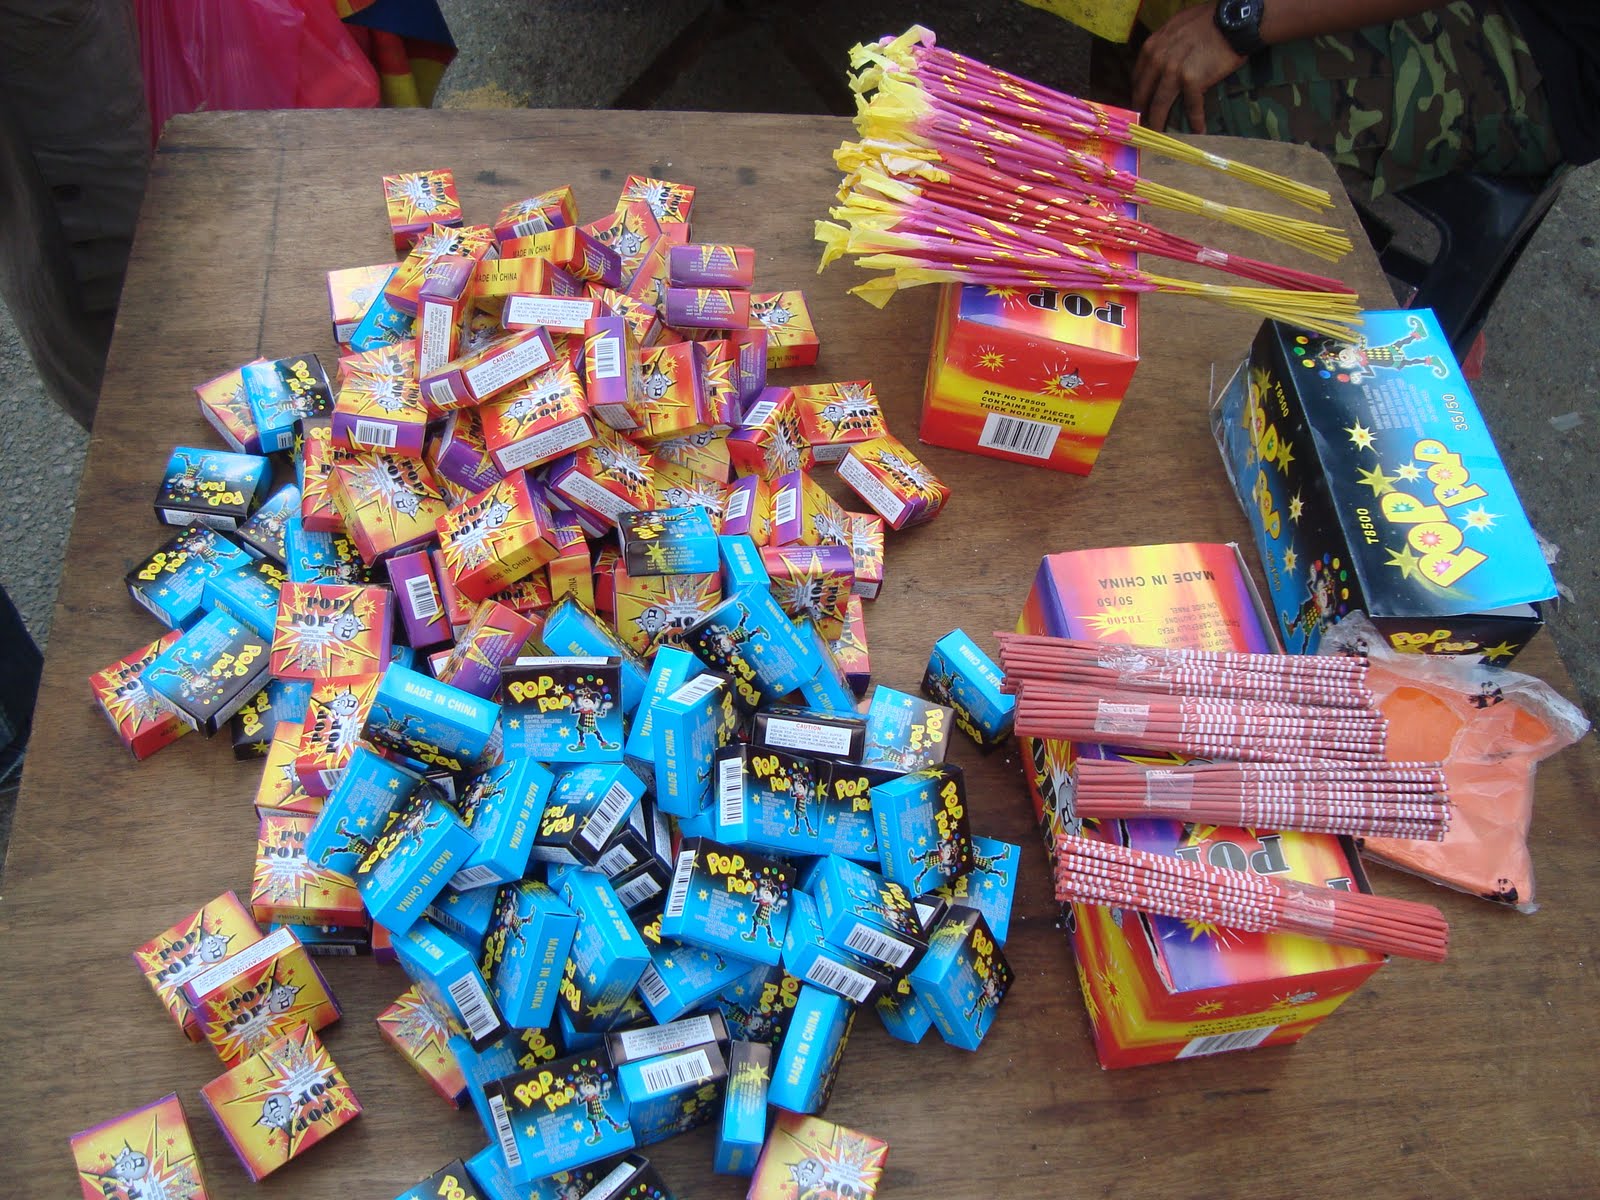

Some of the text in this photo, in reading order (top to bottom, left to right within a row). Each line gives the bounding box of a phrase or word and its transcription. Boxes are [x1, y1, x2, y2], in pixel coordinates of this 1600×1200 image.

[434, 181, 445, 201] POP
[670, 195, 682, 212] POP
[513, 245, 551, 257] MADE IN CHINA
[492, 273, 517, 281] IN CHINA
[1027, 288, 1126, 328] POP
[492, 349, 515, 364] CAUTION
[290, 360, 316, 385] POP
[535, 387, 571, 407] POP
[982, 397, 1027, 409] CONTAINS
[1044, 409, 1075, 419] PIECES
[1020, 398, 1046, 406] T8500
[1274, 381, 1289, 418] T8500
[527, 403, 562, 422] POP
[842, 420, 872, 429] POP
[848, 409, 878, 417] POP
[980, 403, 1076, 425] TRICK NOISE MAKERS
[1442, 394, 1468, 431] 35/50
[535, 444, 562, 458] CAUTION
[382, 455, 404, 486] POP
[402, 460, 424, 491] POP
[865, 472, 884, 490] CAUTION
[1414, 438, 1488, 508] POP
[199, 481, 226, 492] POP
[208, 490, 245, 506] POP
[458, 499, 490, 523] POP
[450, 519, 483, 542] POP
[1357, 508, 1379, 545] T8500
[333, 539, 351, 561] POP
[1381, 491, 1488, 588] POP
[139, 552, 167, 581] POP
[164, 552, 188, 573] POP
[512, 556, 533, 569] CHINA
[1098, 571, 1215, 589] MADE IN CHINA
[307, 597, 345, 609] POP
[826, 586, 838, 611] POP
[1097, 595, 1133, 607] 50/50
[1191, 604, 1206, 612] SIDE
[292, 613, 329, 627] POP
[1107, 614, 1142, 624] T8500
[1157, 627, 1174, 635] READ
[1164, 615, 1196, 624] CAUTIONS
[1390, 630, 1452, 645] POP
[1433, 642, 1479, 652] POP
[211, 652, 235, 677] POP
[233, 645, 262, 676] POP
[959, 645, 981, 666] CHINA
[508, 675, 554, 703] POP
[656, 668, 672, 694] MADE
[404, 682, 478, 718] MADE IN CHINA
[538, 695, 572, 713] POP
[722, 691, 735, 730] POP
[312, 710, 329, 742] POP
[326, 720, 339, 753] POP
[910, 724, 922, 750] POP
[925, 708, 943, 743] POP
[420, 753, 462, 771] POP
[665, 729, 678, 796] MADE IN CHINA
[752, 755, 780, 779] POP
[770, 775, 791, 792] POP
[834, 777, 870, 800] POP
[941, 782, 964, 820] POP
[509, 782, 540, 849] MADE IN CHINA
[542, 814, 575, 836] POP
[879, 812, 889, 838] MADE
[935, 810, 950, 840] POP
[281, 831, 306, 841] PO
[358, 836, 388, 874] POP
[707, 852, 744, 875] POP
[396, 850, 453, 913] MADE IN CHINA
[727, 876, 755, 895] POP
[159, 932, 196, 960] POP
[972, 929, 993, 956] POP
[156, 954, 193, 982] POP
[482, 936, 494, 979] POP
[531, 938, 559, 1009] MADE IN CHINA
[228, 982, 267, 1011] POP
[759, 983, 779, 1013] POP
[224, 1004, 262, 1033] POP
[658, 1041, 685, 1052] CAUTION
[786, 1010, 821, 1085] MADE IN CHINA
[300, 1075, 337, 1107] POP
[514, 1071, 553, 1108] POP
[545, 1087, 575, 1113] POP
[296, 1100, 335, 1133] POP
